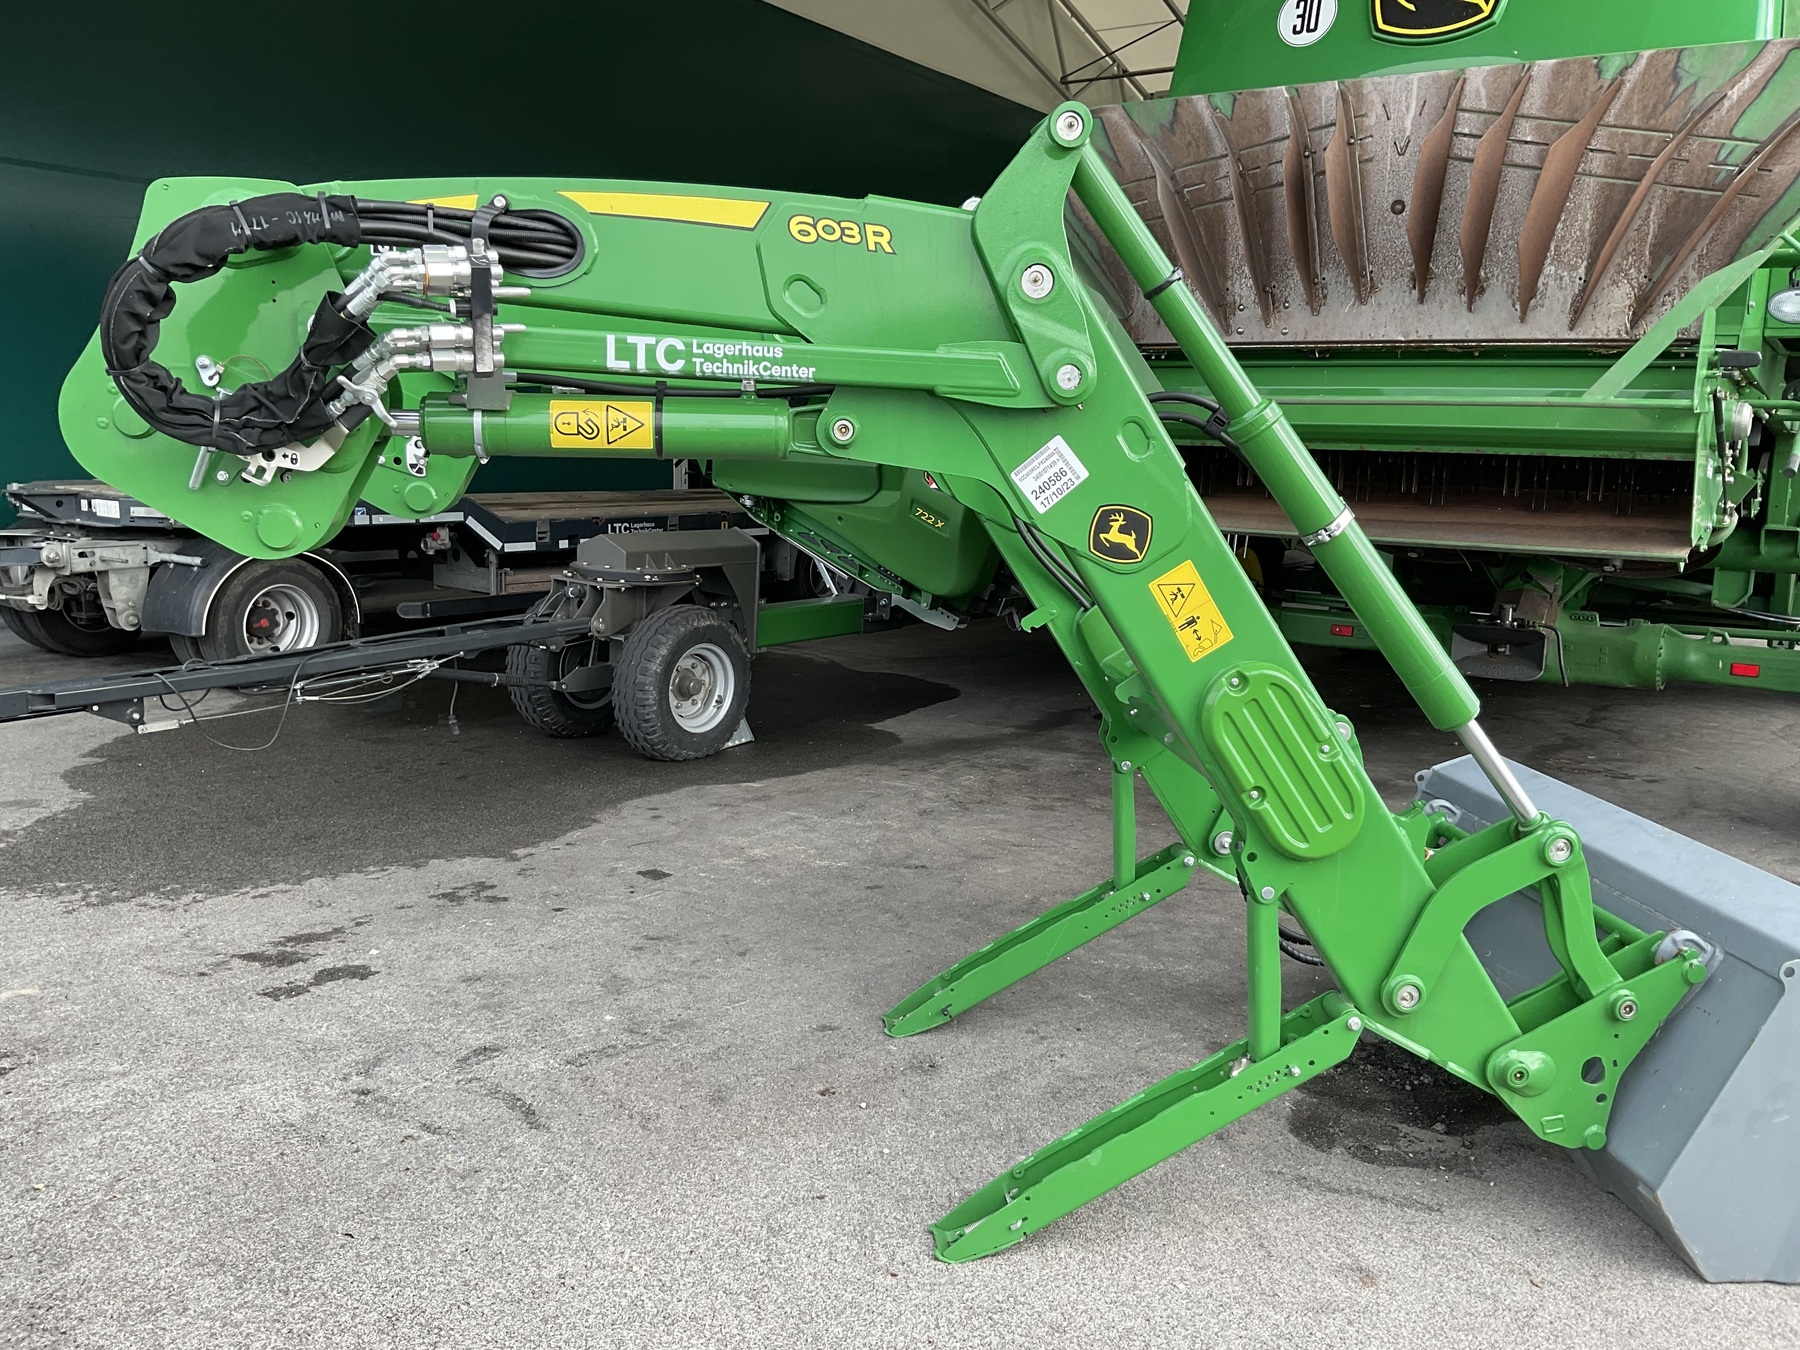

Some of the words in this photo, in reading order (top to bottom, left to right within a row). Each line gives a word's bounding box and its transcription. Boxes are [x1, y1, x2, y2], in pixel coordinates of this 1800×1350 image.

[1292, 0, 1321, 35] 30
[788, 214, 897, 255] 603R
[606, 334, 686, 371] LTC
[692, 339, 783, 358] Lagerhaus
[692, 357, 816, 379] TechnikCenter
[1031, 467, 1068, 500] 240586
[1040, 478, 1075, 508] 17/10/23
[608, 523, 630, 534] LTC
